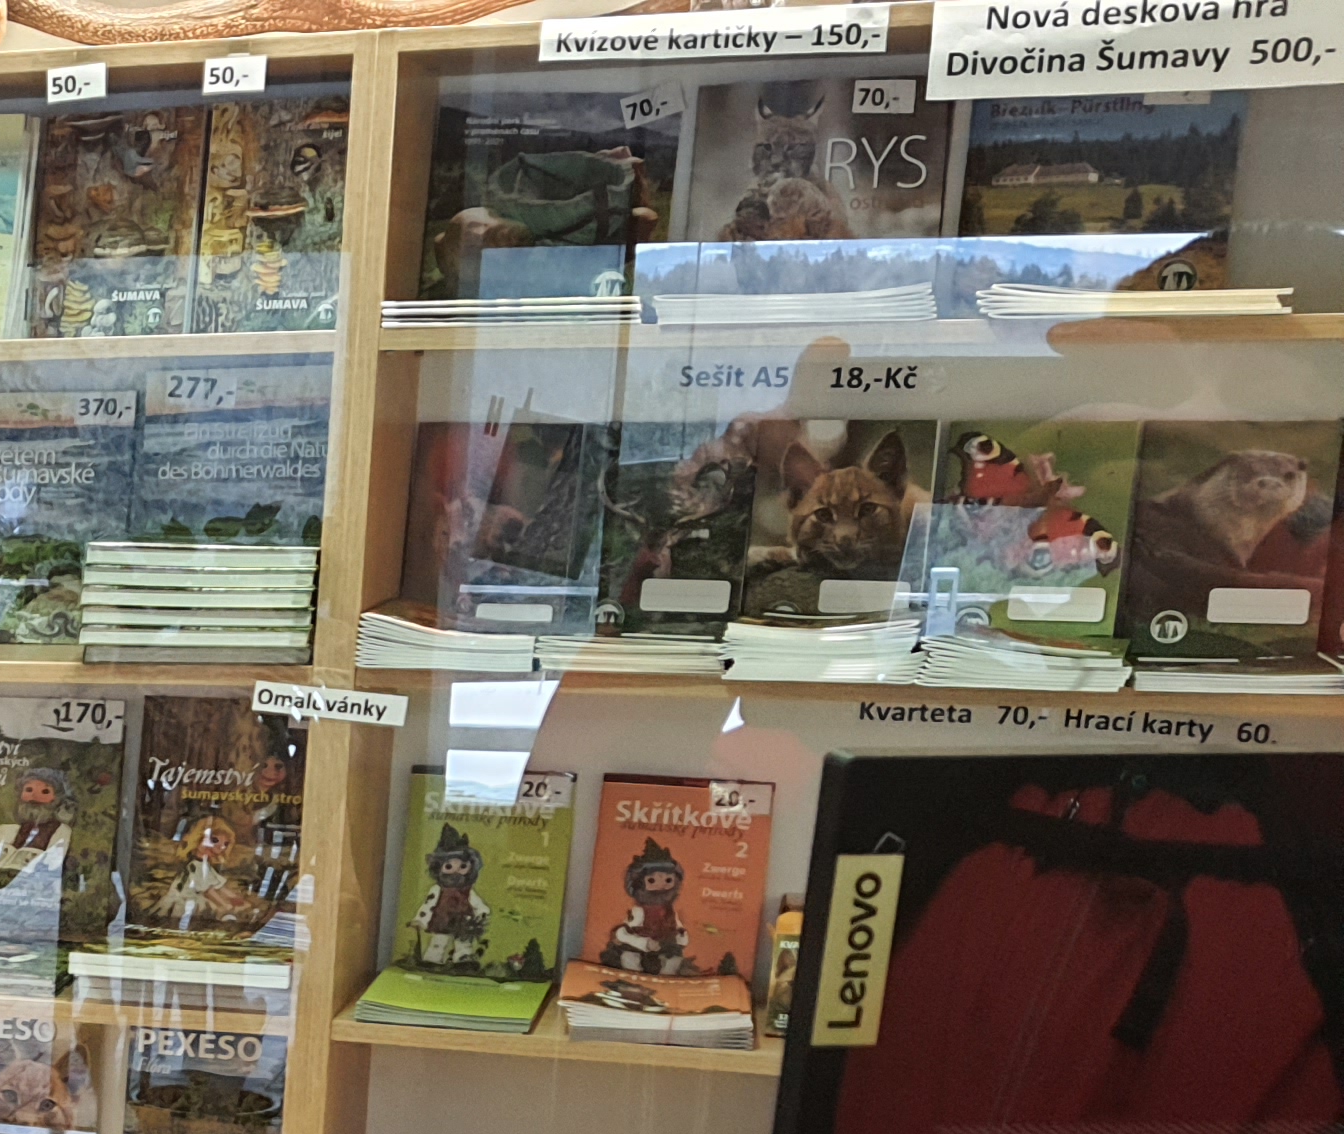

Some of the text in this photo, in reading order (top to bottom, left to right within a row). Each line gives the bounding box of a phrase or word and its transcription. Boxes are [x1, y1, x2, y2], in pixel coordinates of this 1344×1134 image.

[987, 4, 1069, 30] Nová
[556, 23, 881, 53] Kvízové kartičky 150,-
[947, 37, 1336, 77] Divočina Šumavy 500,-
[52, 75, 91, 95] 50,-
[208, 66, 249, 87] 50,-
[625, 98, 668, 122] 70,-
[857, 87, 900, 108] 70,-
[824, 134, 928, 190] RYS
[167, 375, 235, 405] 277,-
[679, 364, 918, 392] Sešit A5 18,-Kč
[78, 398, 132, 419] 370,-
[208, 440, 287, 459] durch die
[158, 460, 321, 480] des Böhmerwaldes
[59, 702, 124, 729] 170,-
[859, 701, 1213, 743] Kvarteta 70,- Hrací karty
[148, 757, 260, 790] Tajemství
[181, 787, 270, 805] šumavských
[523, 782, 562, 801] 20,-
[715, 790, 756, 808] 20,-
[616, 800, 752, 831] Skřítkové
[736, 842, 748, 858] 2
[827, 872, 882, 1029] Lenovo
[137, 1027, 263, 1062] PEXESO
